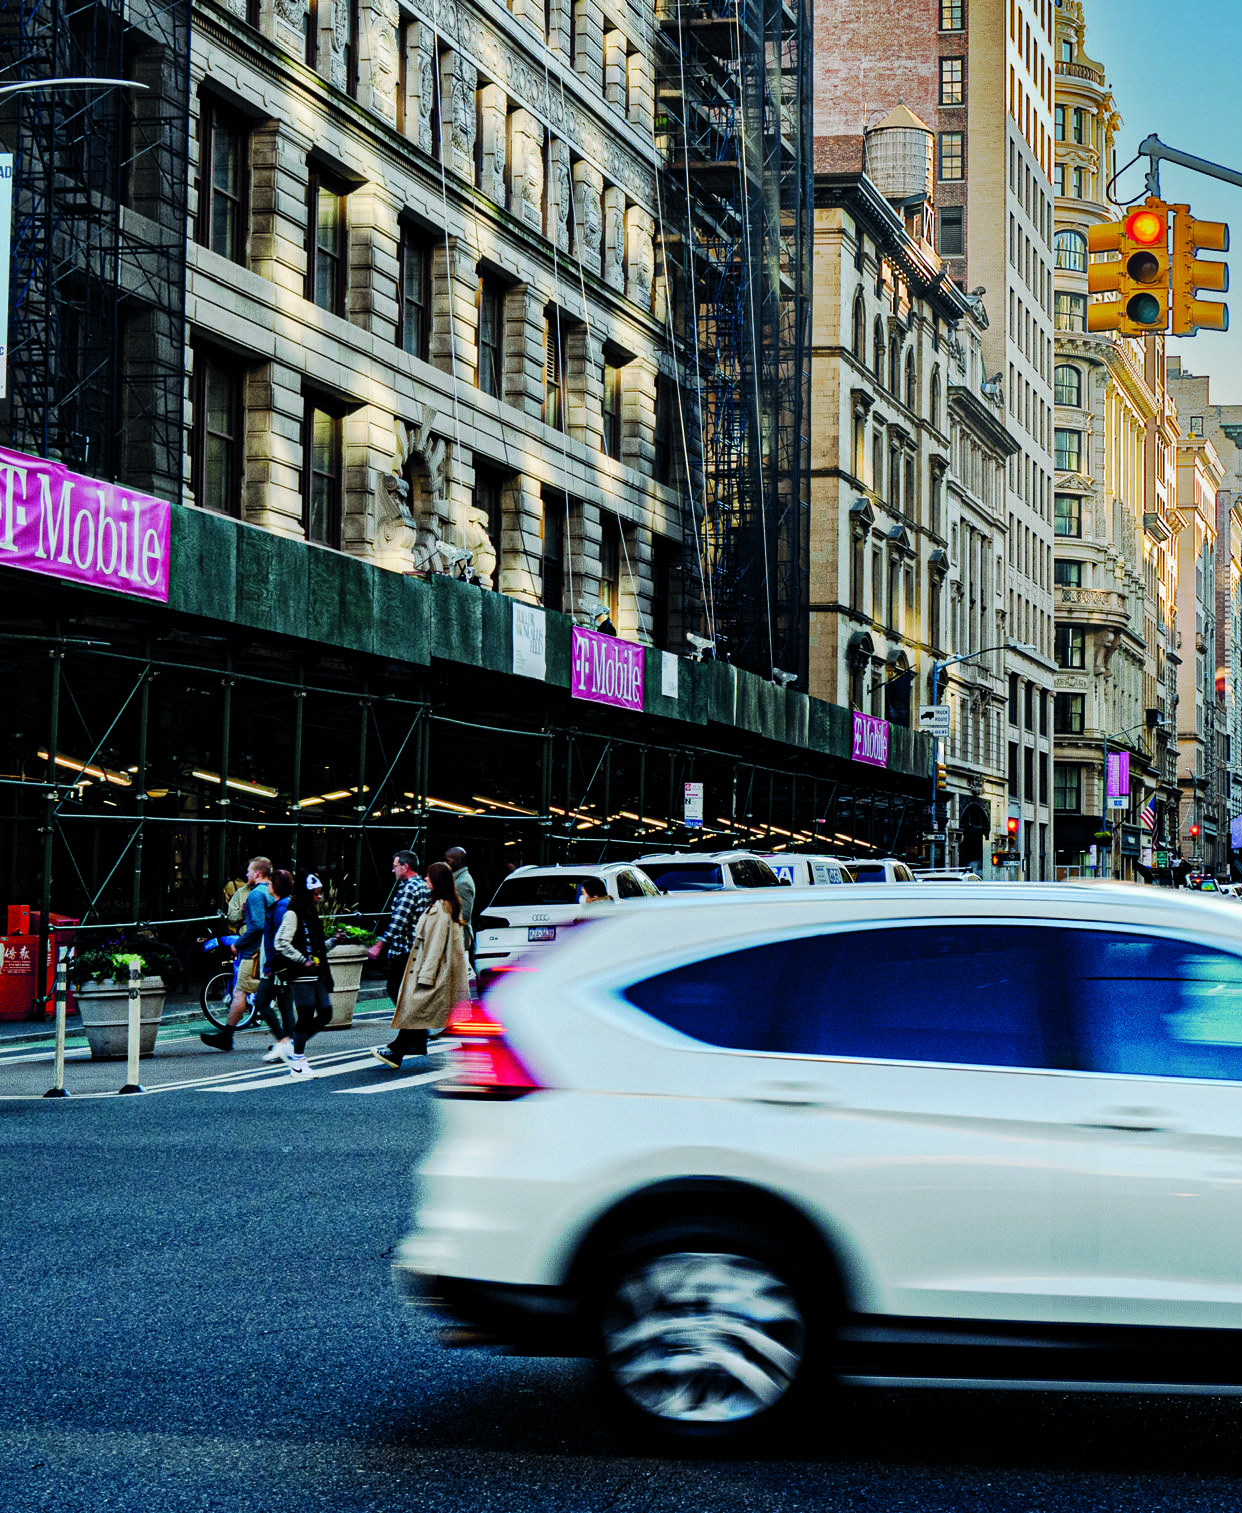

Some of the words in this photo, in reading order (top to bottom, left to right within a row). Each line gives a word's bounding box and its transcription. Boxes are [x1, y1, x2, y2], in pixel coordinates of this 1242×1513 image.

[35, 473, 160, 586] Mobile
[591, 640, 641, 703] Mobile
[862, 719, 888, 761] Mobile
